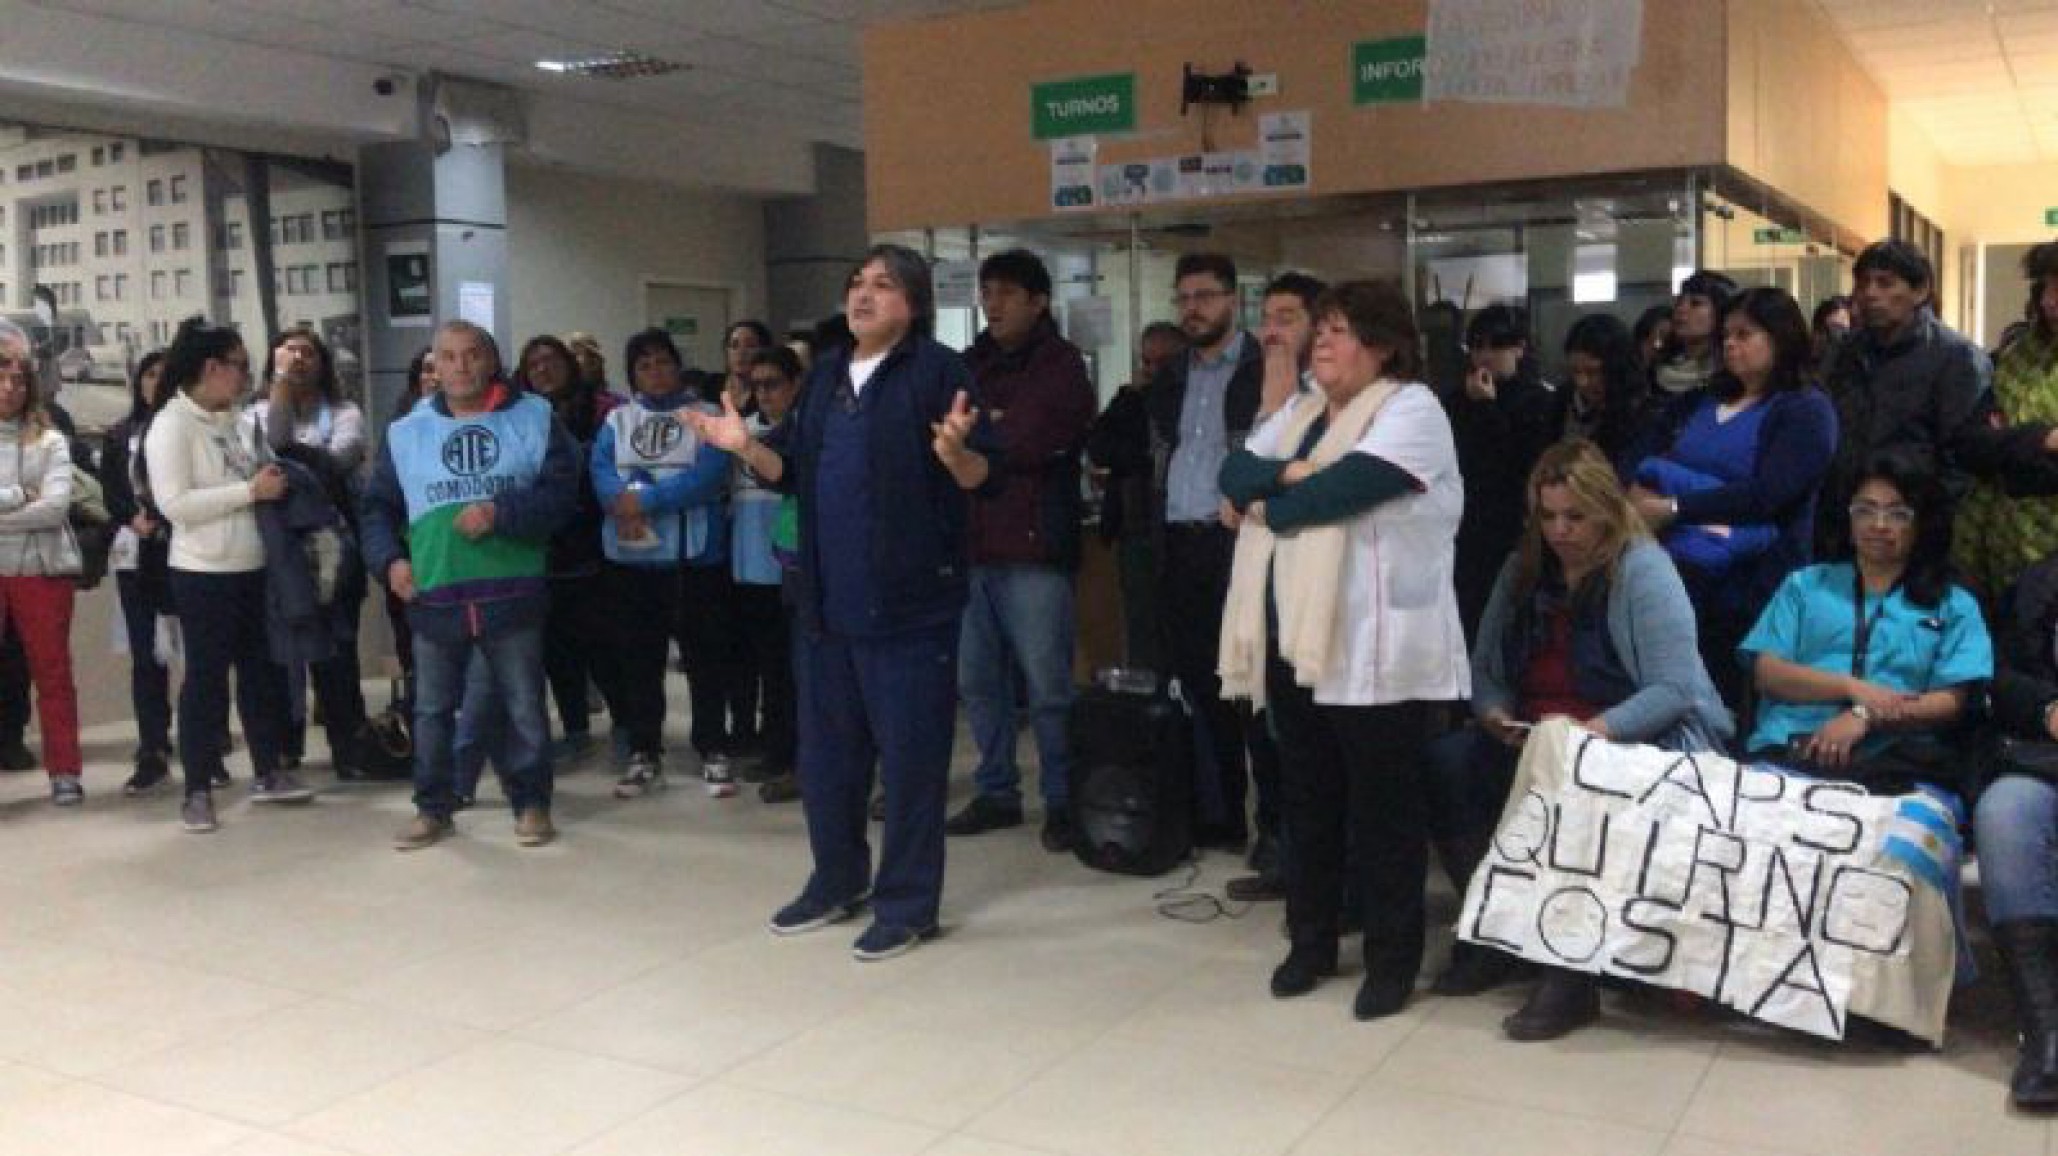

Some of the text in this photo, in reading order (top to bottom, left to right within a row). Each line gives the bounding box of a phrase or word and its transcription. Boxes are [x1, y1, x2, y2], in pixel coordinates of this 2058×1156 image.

[1045, 94, 1120, 121] TURNOS
[448, 429, 498, 473] ATE
[1573, 734, 1871, 855] CAPS
[1492, 788, 1912, 956] QUIRNO
[1472, 864, 1842, 1035] COSTA
